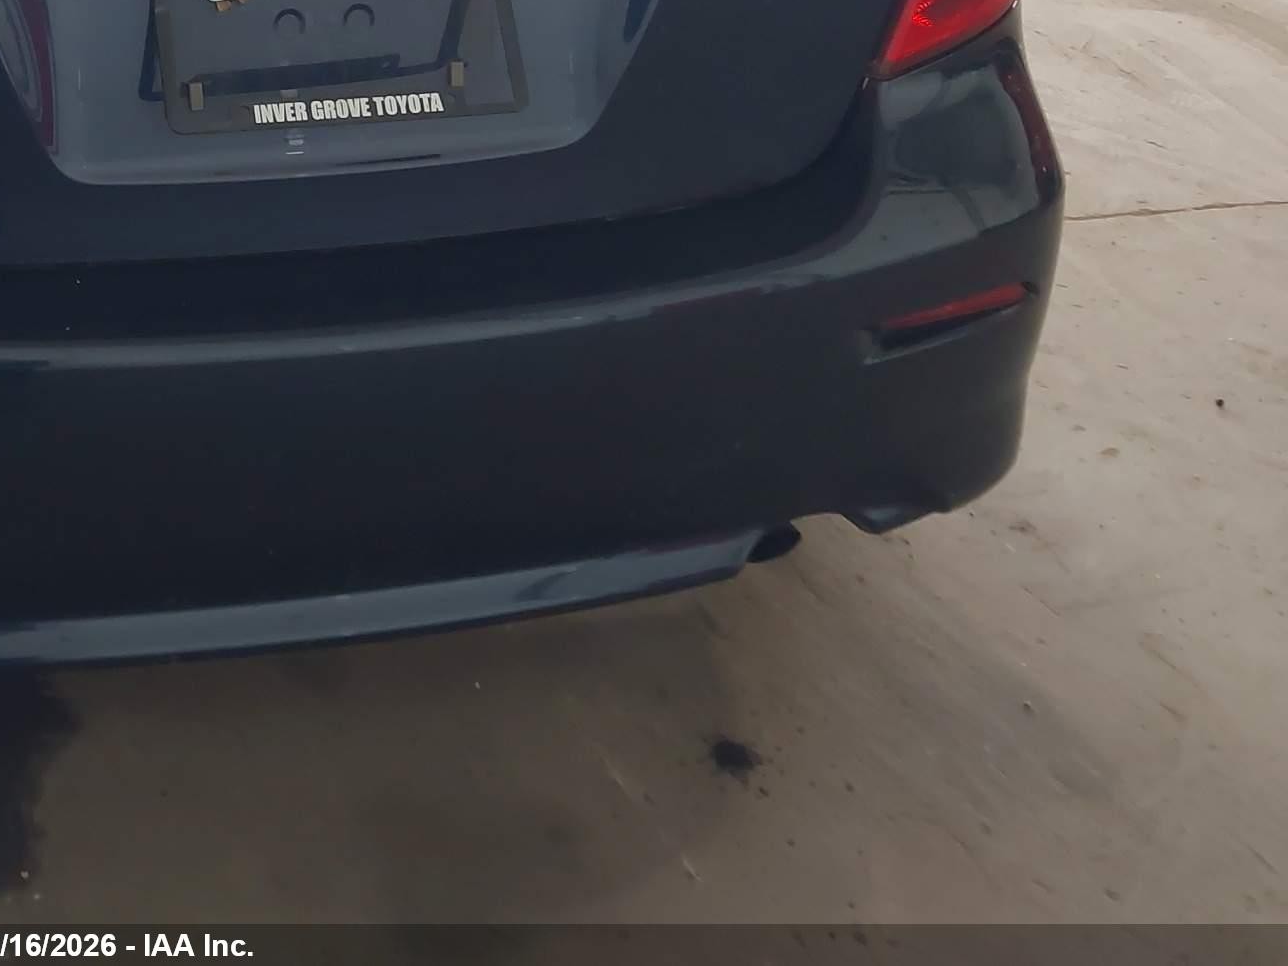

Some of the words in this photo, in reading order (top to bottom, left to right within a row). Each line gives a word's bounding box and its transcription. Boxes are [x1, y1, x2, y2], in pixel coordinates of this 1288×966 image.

[253, 102, 308, 124] INVER
[311, 97, 371, 121] GROVE
[372, 92, 445, 116] TOYOTA
